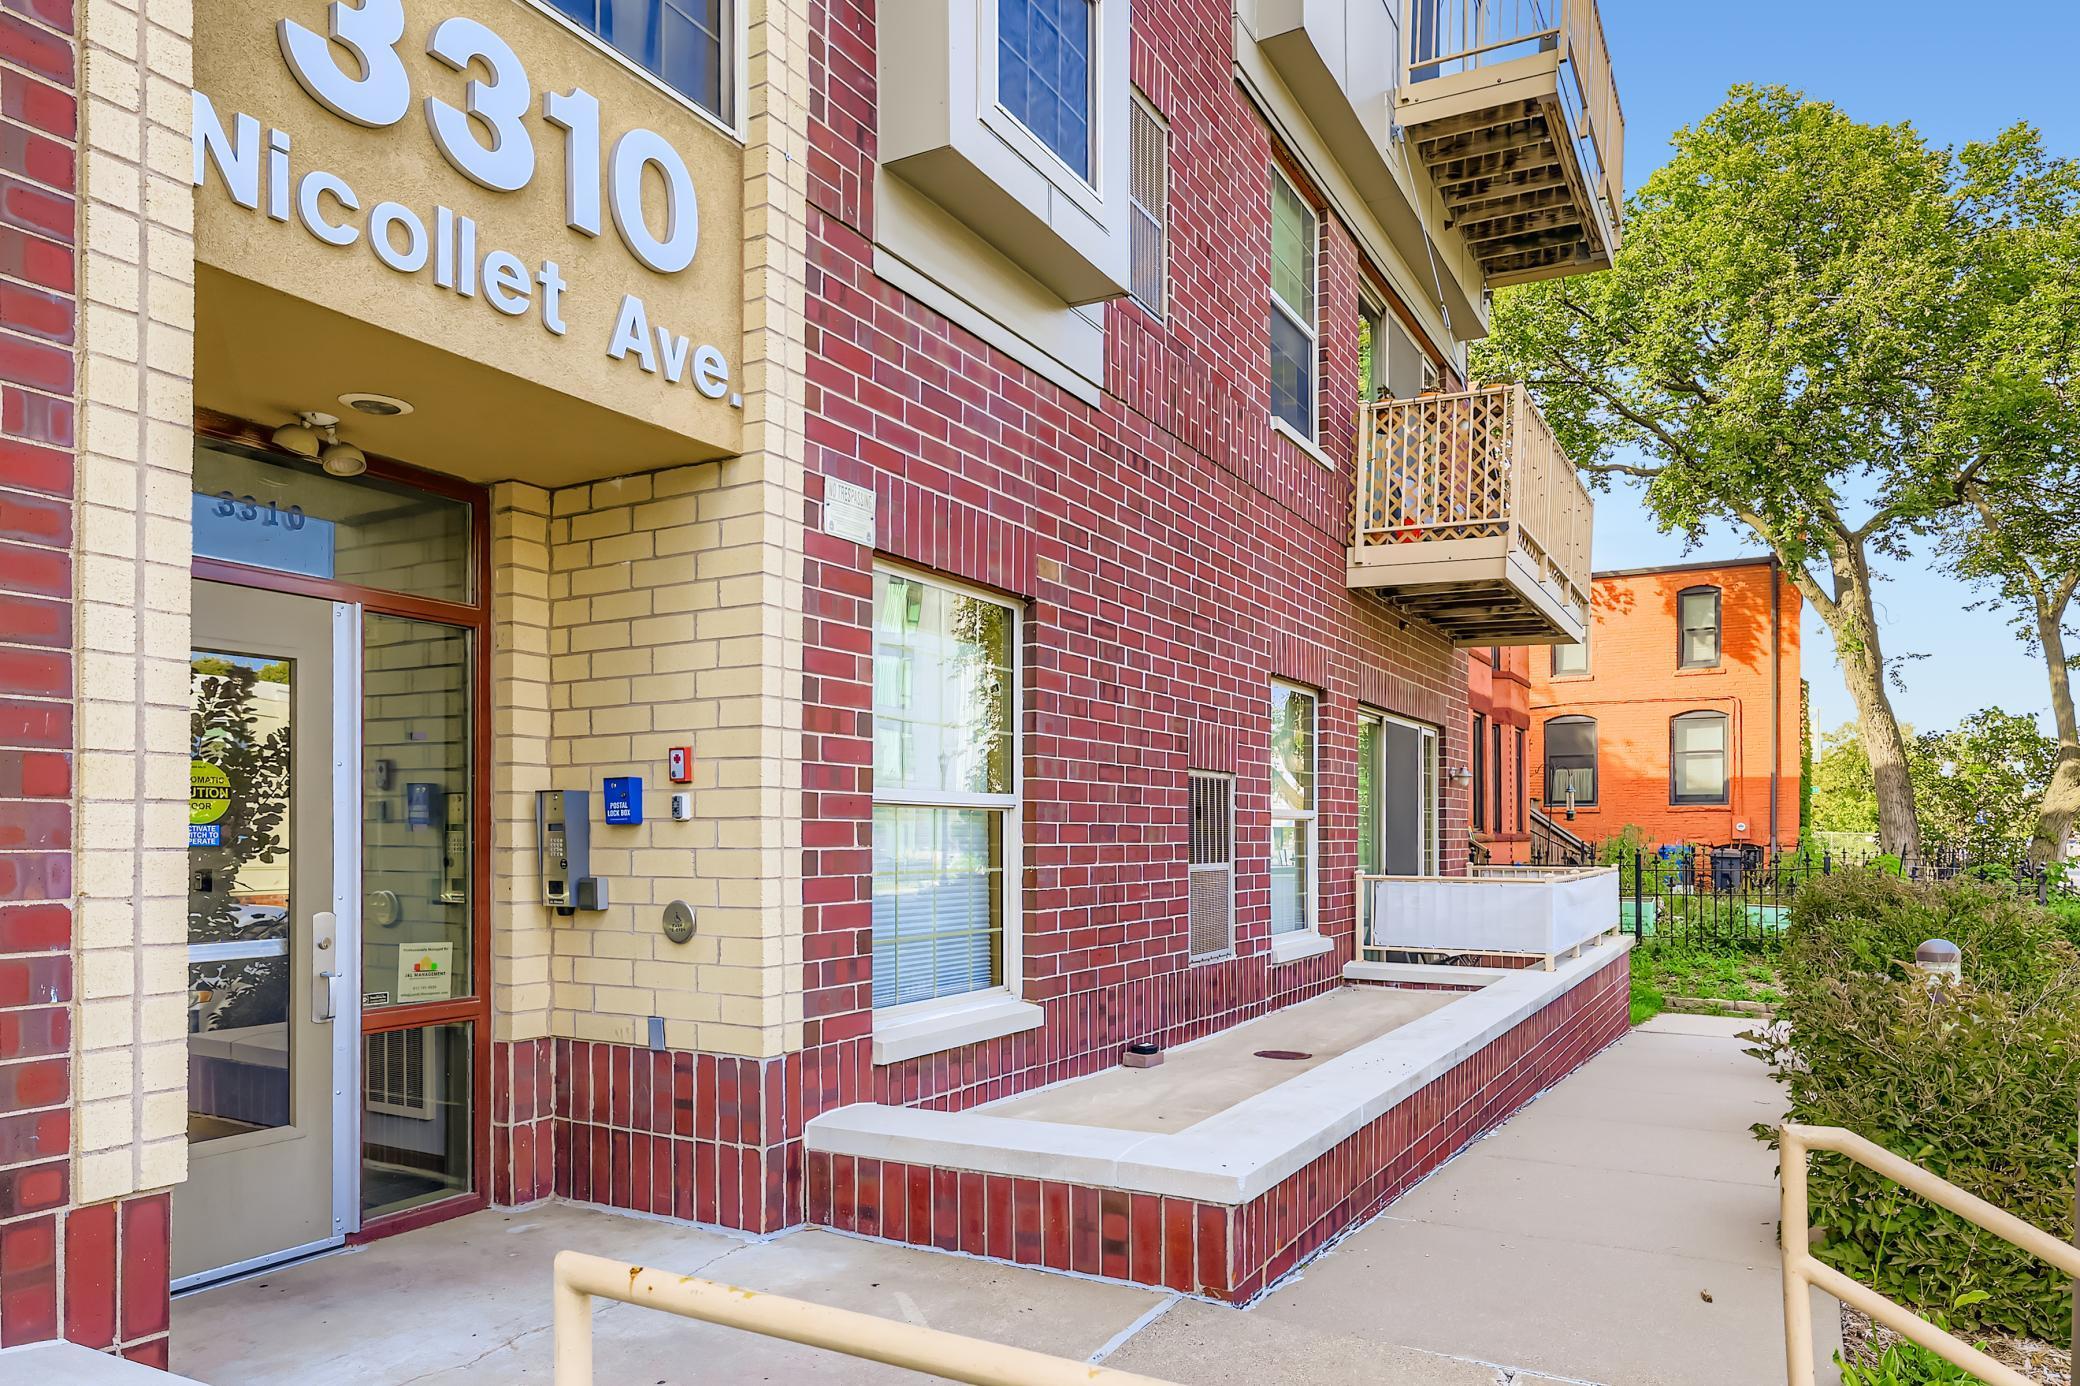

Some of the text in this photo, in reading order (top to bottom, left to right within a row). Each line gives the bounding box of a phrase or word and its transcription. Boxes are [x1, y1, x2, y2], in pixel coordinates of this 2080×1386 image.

[276, 0, 699, 274] 3310
[192, 89, 743, 409] Nicollet Ave.
[828, 480, 873, 510] NO TRESPASSING
[213, 490, 305, 531] 3310
[190, 775, 225, 784] OMATIC
[191, 786, 229, 799] UTION
[190, 802, 212, 810] OOR
[609, 801, 628, 809] POSTAL
[607, 809, 631, 817] LOCK BOX
[209, 831, 218, 839] TO
